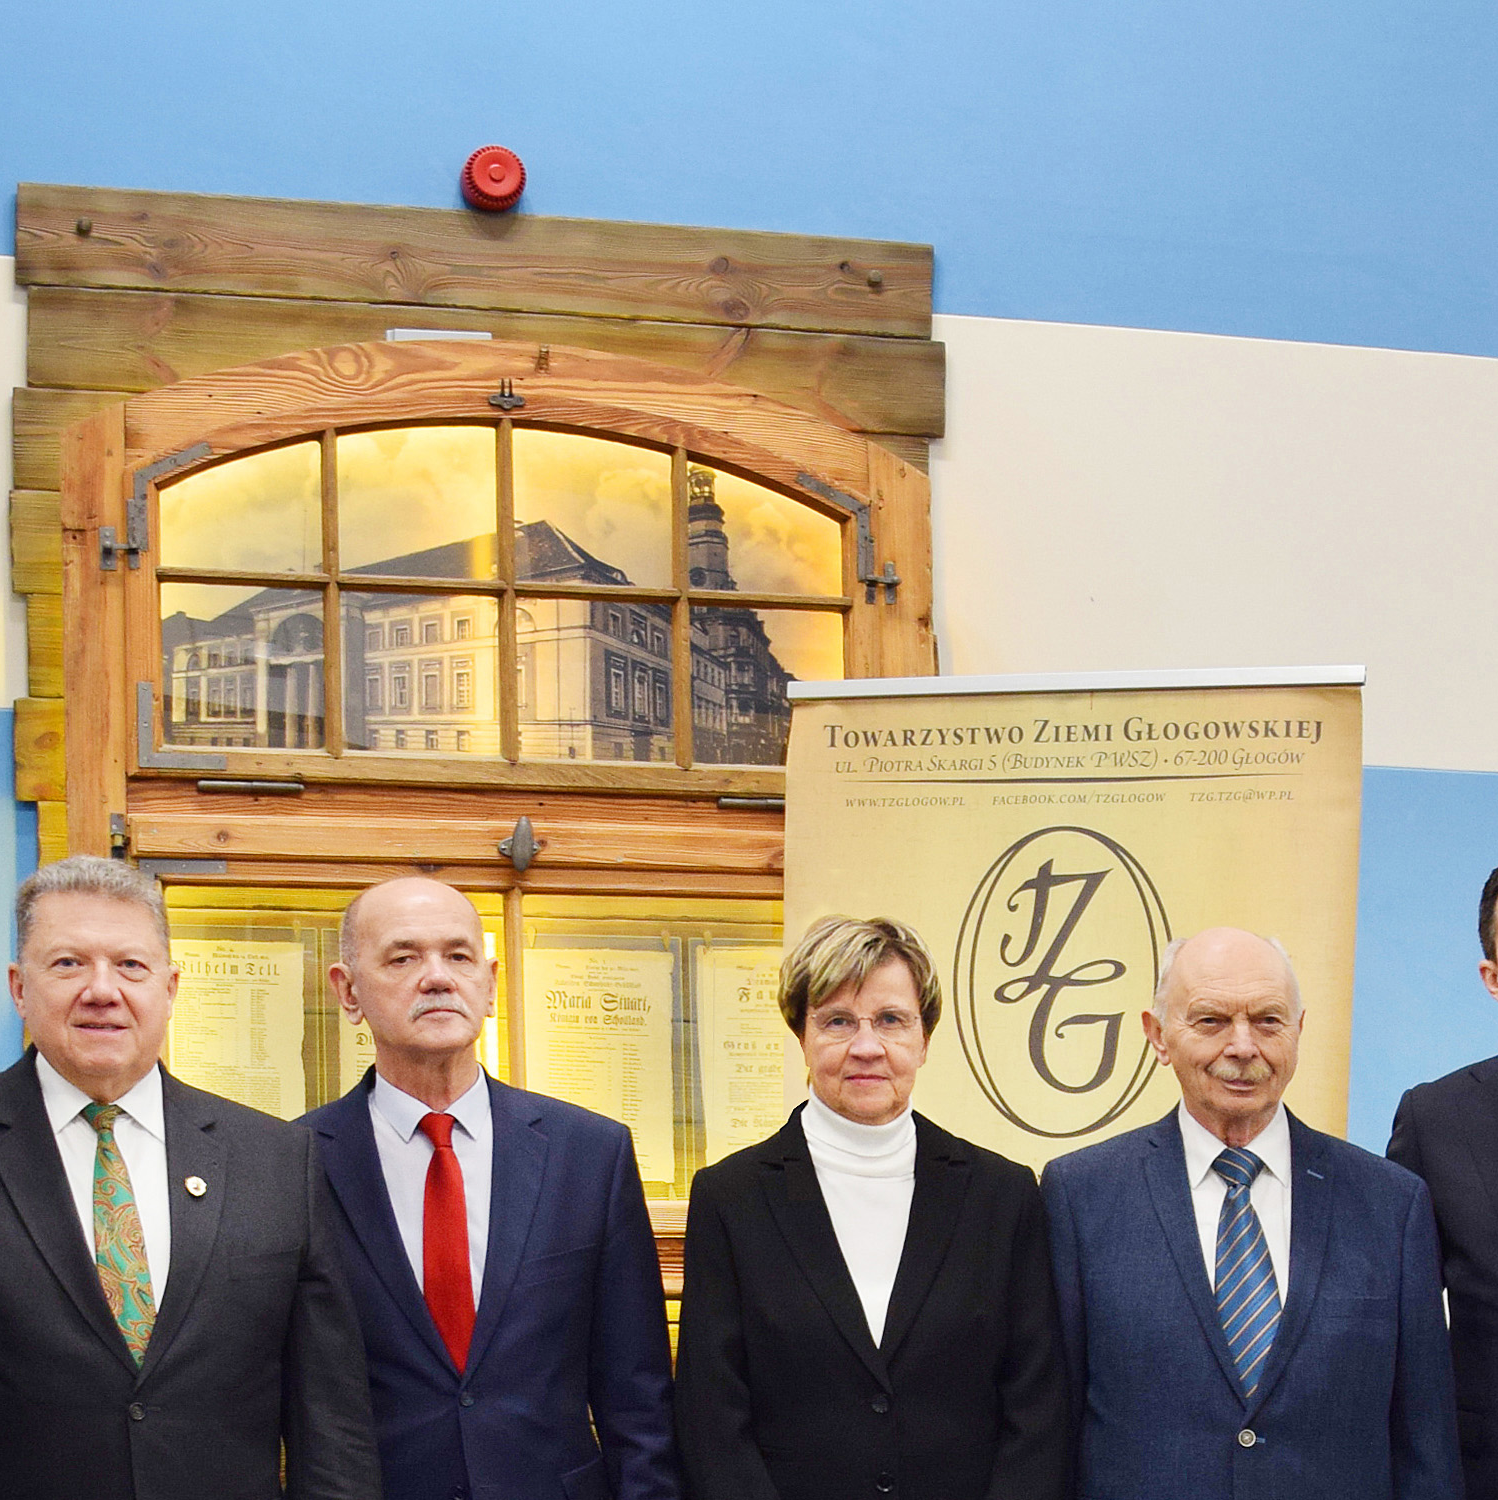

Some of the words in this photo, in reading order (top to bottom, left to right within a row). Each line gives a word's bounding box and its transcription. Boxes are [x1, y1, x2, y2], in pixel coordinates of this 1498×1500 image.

[824, 723, 1024, 749] TOWARZYSTWO
[1033, 719, 1113, 743] ZIEMI
[1123, 716, 1323, 744] GŁOGOWSKIEJ
[987, 755, 997, 771] 5
[1173, 749, 1229, 767] 67-200
[545, 990, 592, 1010] Maria
